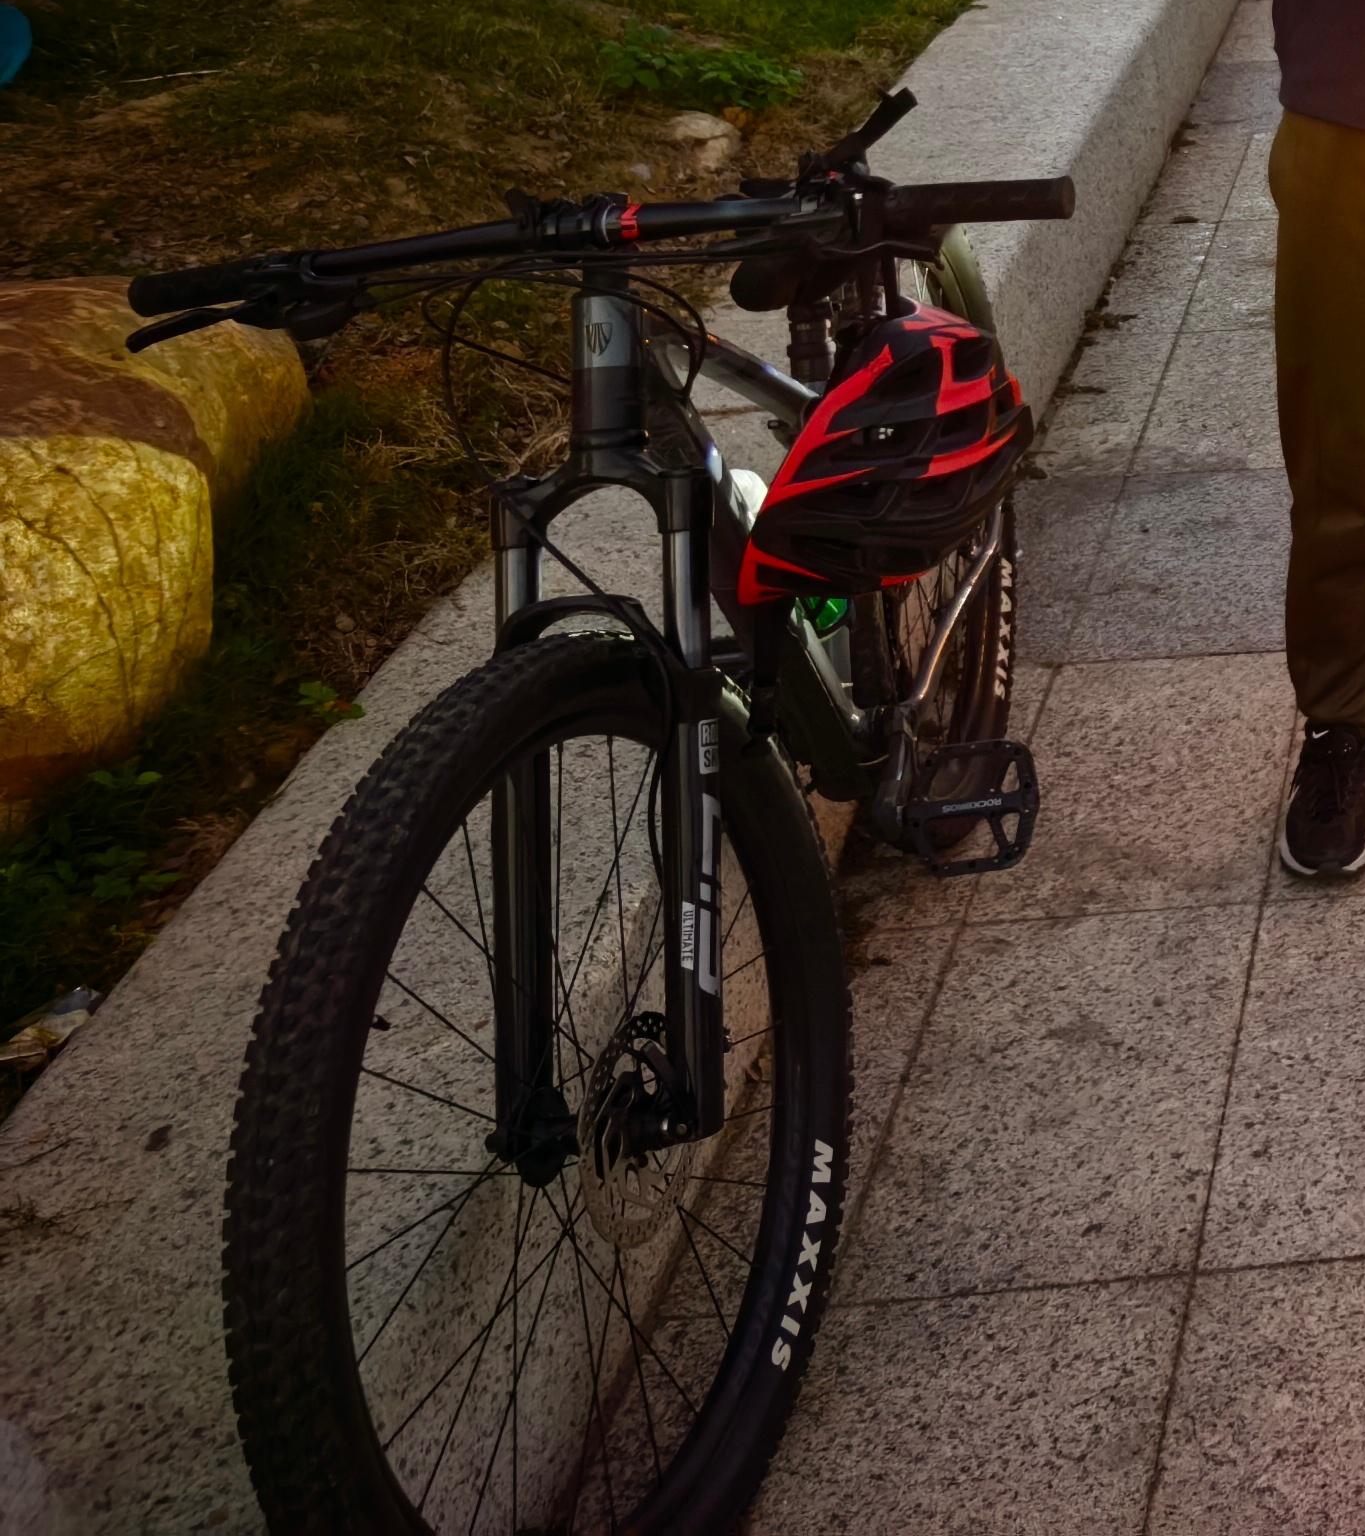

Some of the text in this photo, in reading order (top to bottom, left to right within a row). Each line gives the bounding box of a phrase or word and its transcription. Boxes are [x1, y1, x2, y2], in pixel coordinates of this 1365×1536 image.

[994, 556, 1013, 701] MAXXIS
[682, 908, 695, 963] ULTIMATE
[769, 1137, 835, 1374] MAXXIS
